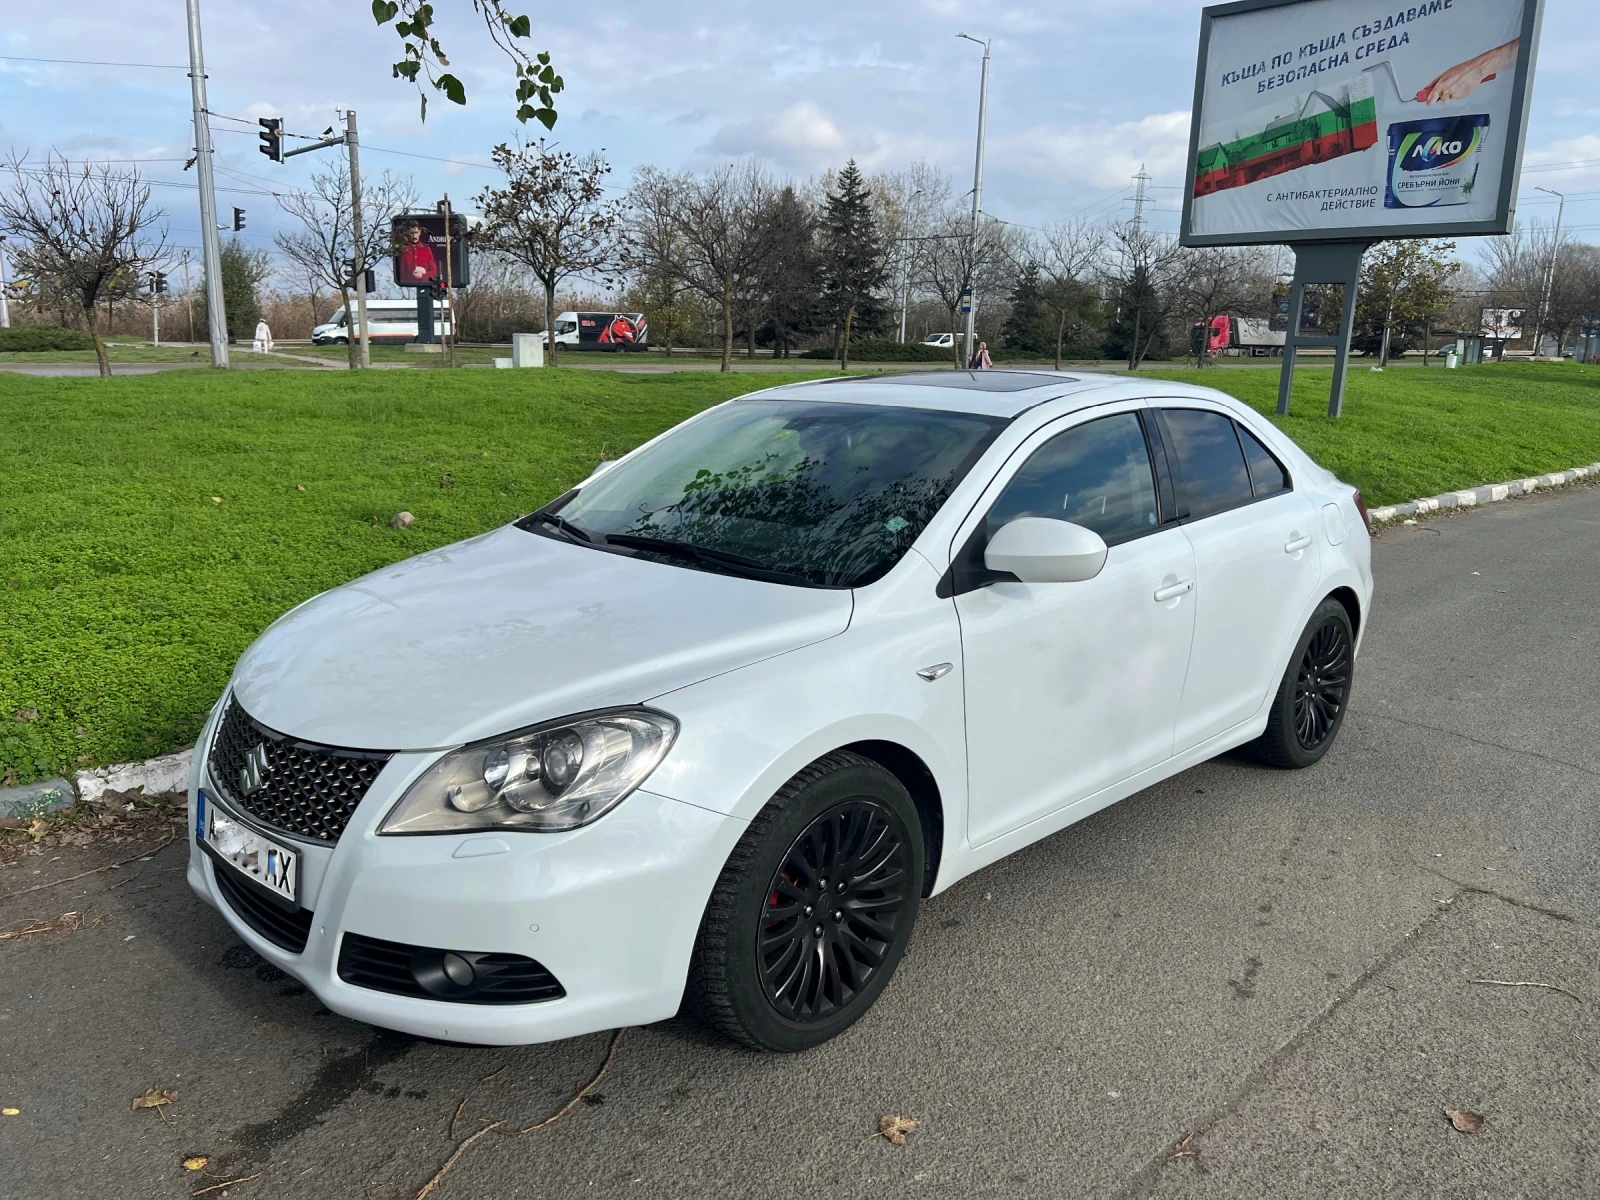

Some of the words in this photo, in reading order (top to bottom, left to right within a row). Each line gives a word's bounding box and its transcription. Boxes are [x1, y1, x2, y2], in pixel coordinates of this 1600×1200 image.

[1221, 61, 1266, 87] КЪЩА
[1271, 51, 1293, 70] ПО
[1299, 32, 1346, 60] КЪЩА
[1257, 51, 1350, 94] БЕЗОПАСНА
[1355, 31, 1410, 60] СРЕДА
[1397, 180, 1437, 189] СРЕБЪРНИ
[1438, 177, 1460, 187] ЙОНИ
[1266, 193, 1273, 202] С
[1275, 186, 1378, 201] АНТИБАКТЕРИАЛНО
[1320, 198, 1376, 212] ДЕЙСТВИЕ
